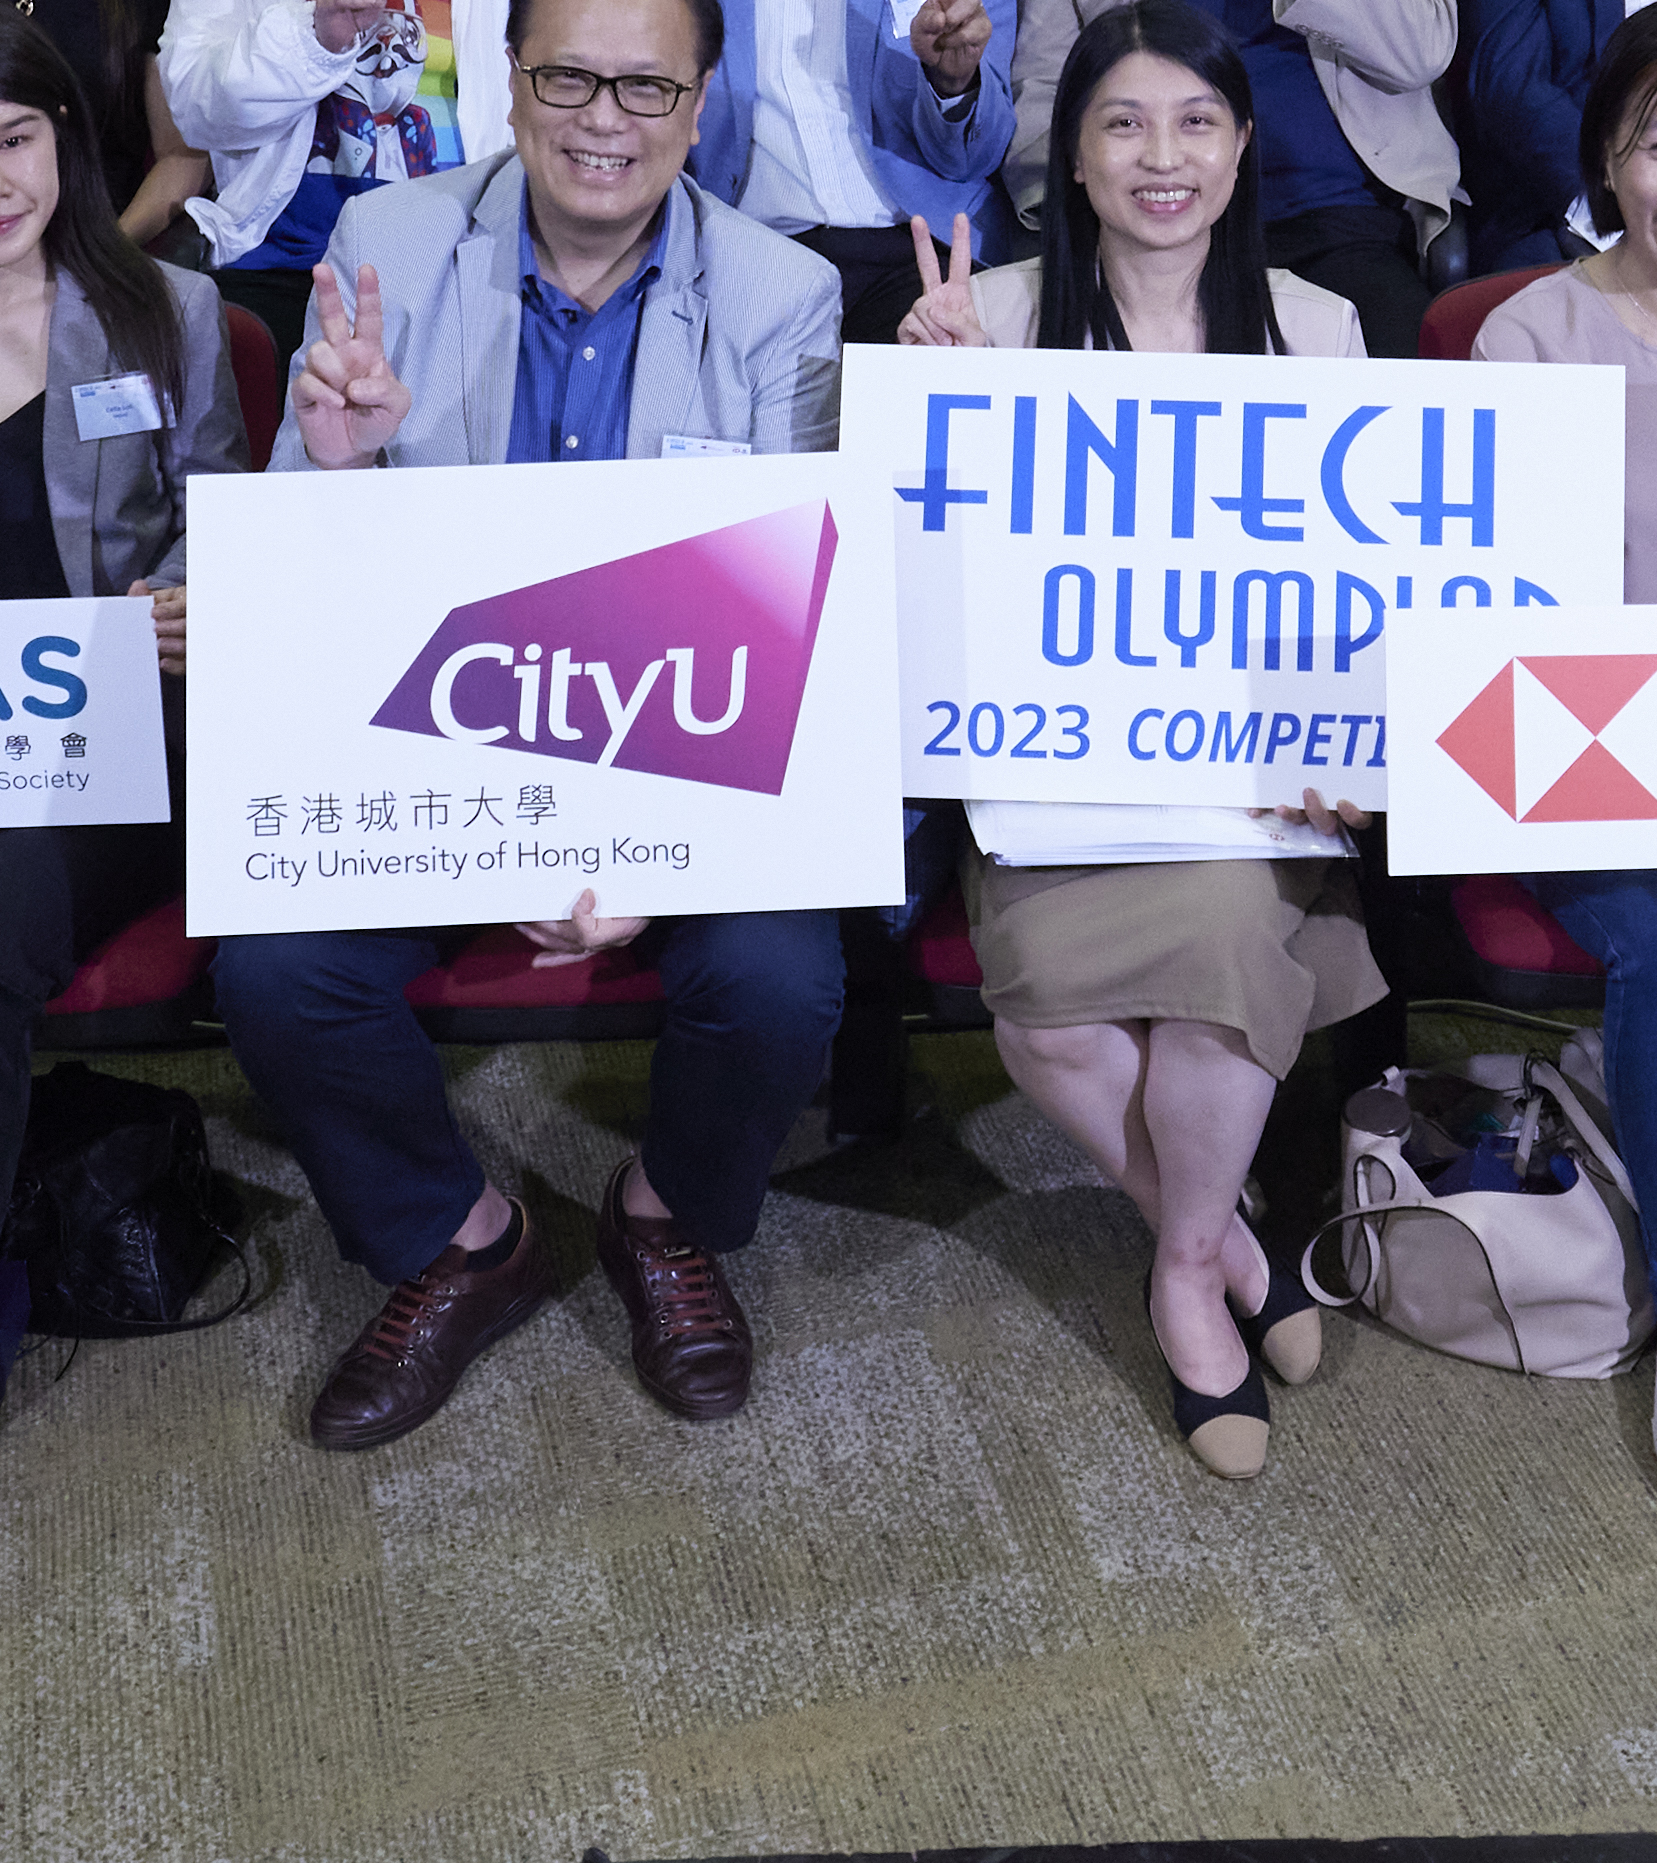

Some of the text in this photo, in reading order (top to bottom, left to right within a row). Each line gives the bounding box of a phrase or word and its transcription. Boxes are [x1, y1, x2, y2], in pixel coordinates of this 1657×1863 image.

[892, 390, 1497, 548] FINTECH
[1041, 563, 1563, 674] OLYMP
[429, 641, 749, 768] CityU
[922, 699, 1388, 770] 2023 COMPETI
[245, 782, 559, 838] 香港城市大學
[244, 836, 691, 887] City University of Hong Kong
